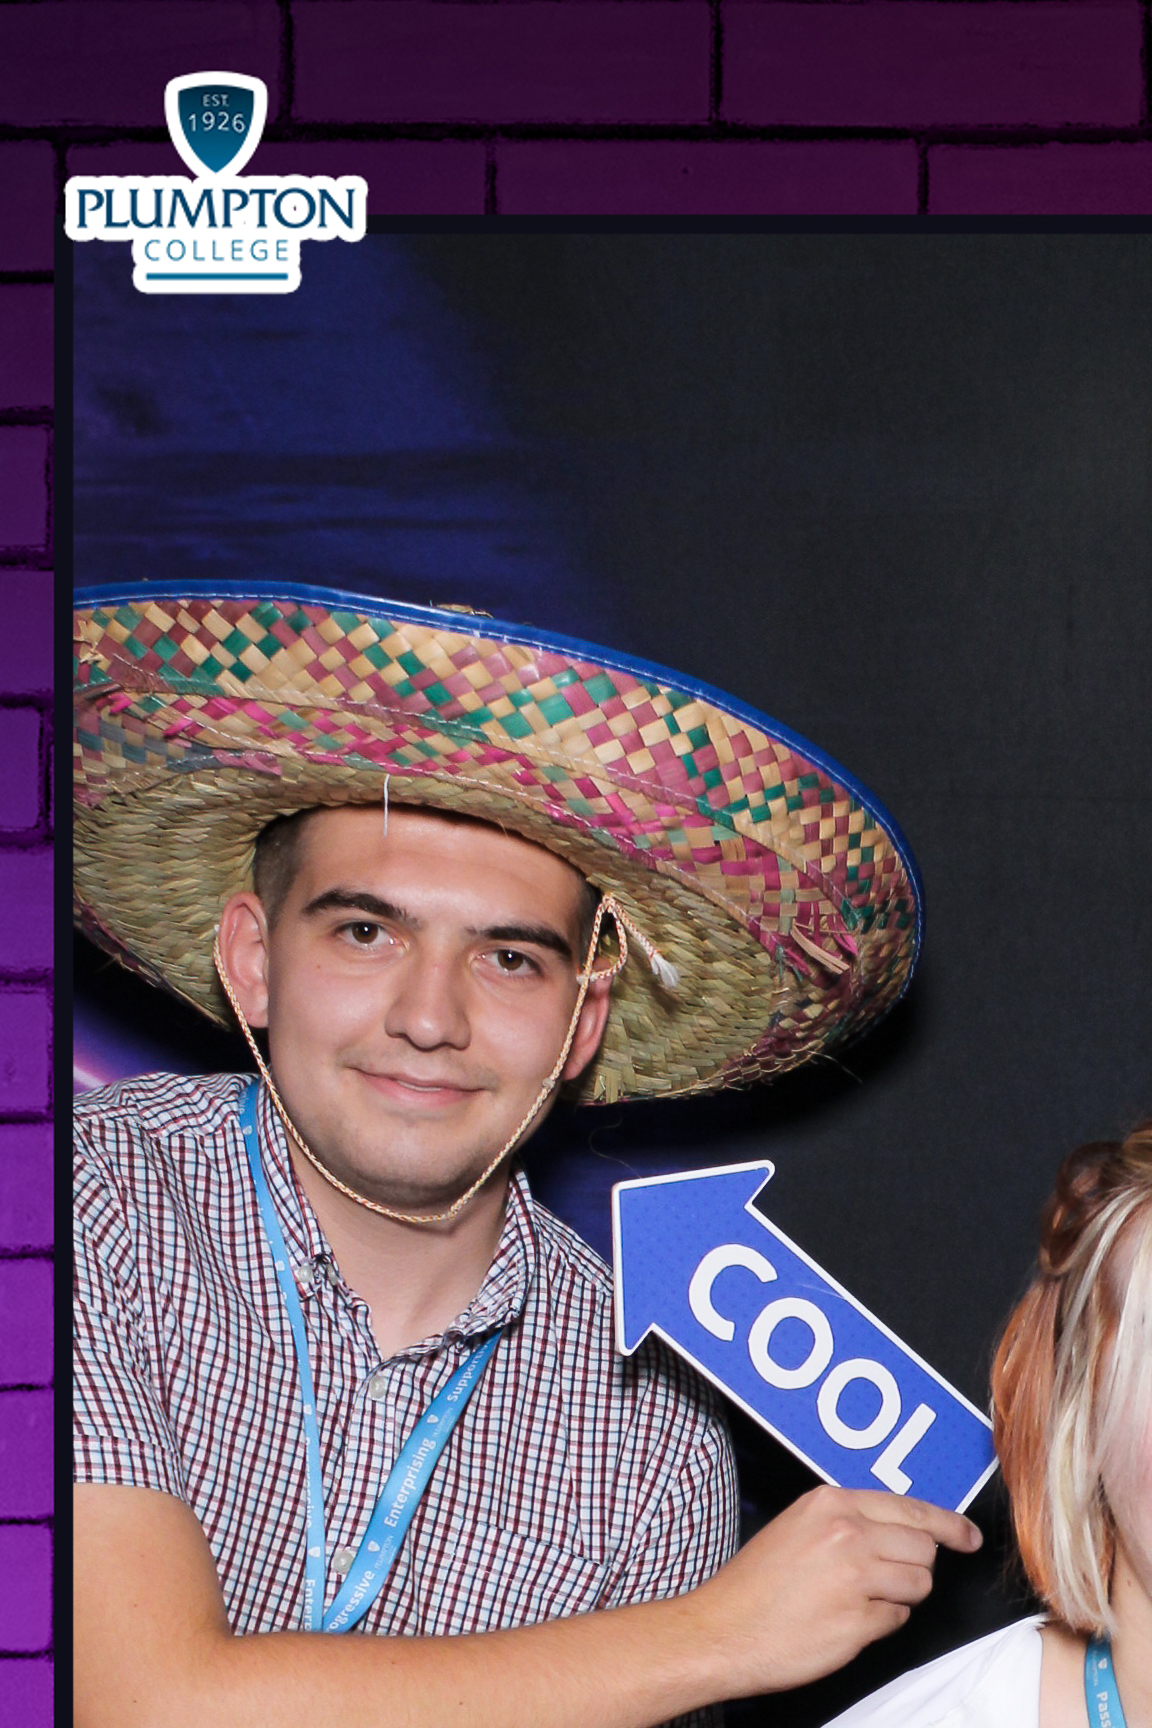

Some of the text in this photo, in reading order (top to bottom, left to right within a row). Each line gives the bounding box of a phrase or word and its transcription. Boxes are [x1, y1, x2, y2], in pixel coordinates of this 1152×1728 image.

[688, 1243, 938, 1496] COOL
[383, 1437, 437, 1528] Enterprising
[327, 1570, 376, 1632] ogressive
